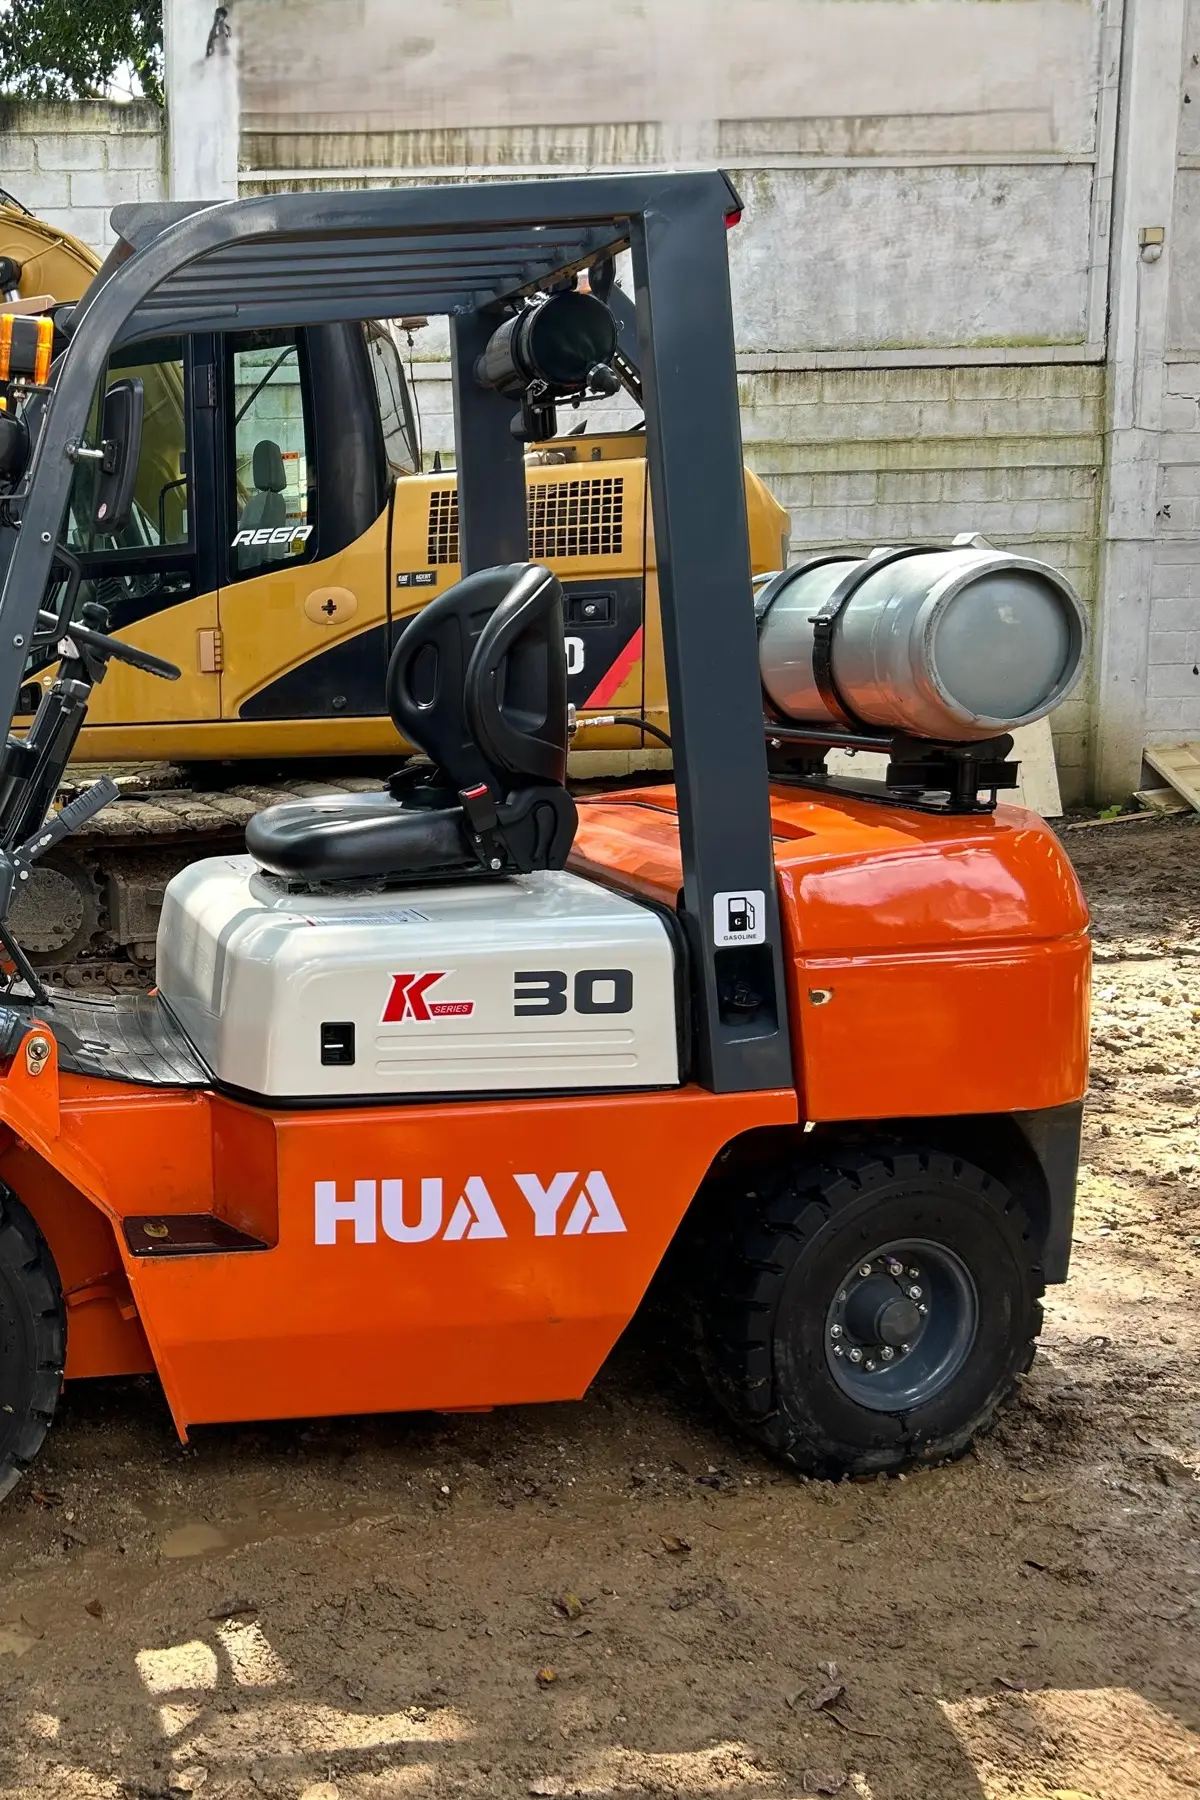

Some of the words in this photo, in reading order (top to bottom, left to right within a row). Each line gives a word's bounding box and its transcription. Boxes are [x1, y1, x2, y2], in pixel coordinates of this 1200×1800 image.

[231, 525, 314, 547] REGA
[734, 917, 742, 926] G
[723, 933, 757, 941] GASOLINE
[381, 972, 448, 1023] K
[433, 1004, 469, 1014] SERIES
[514, 968, 633, 1017] 30
